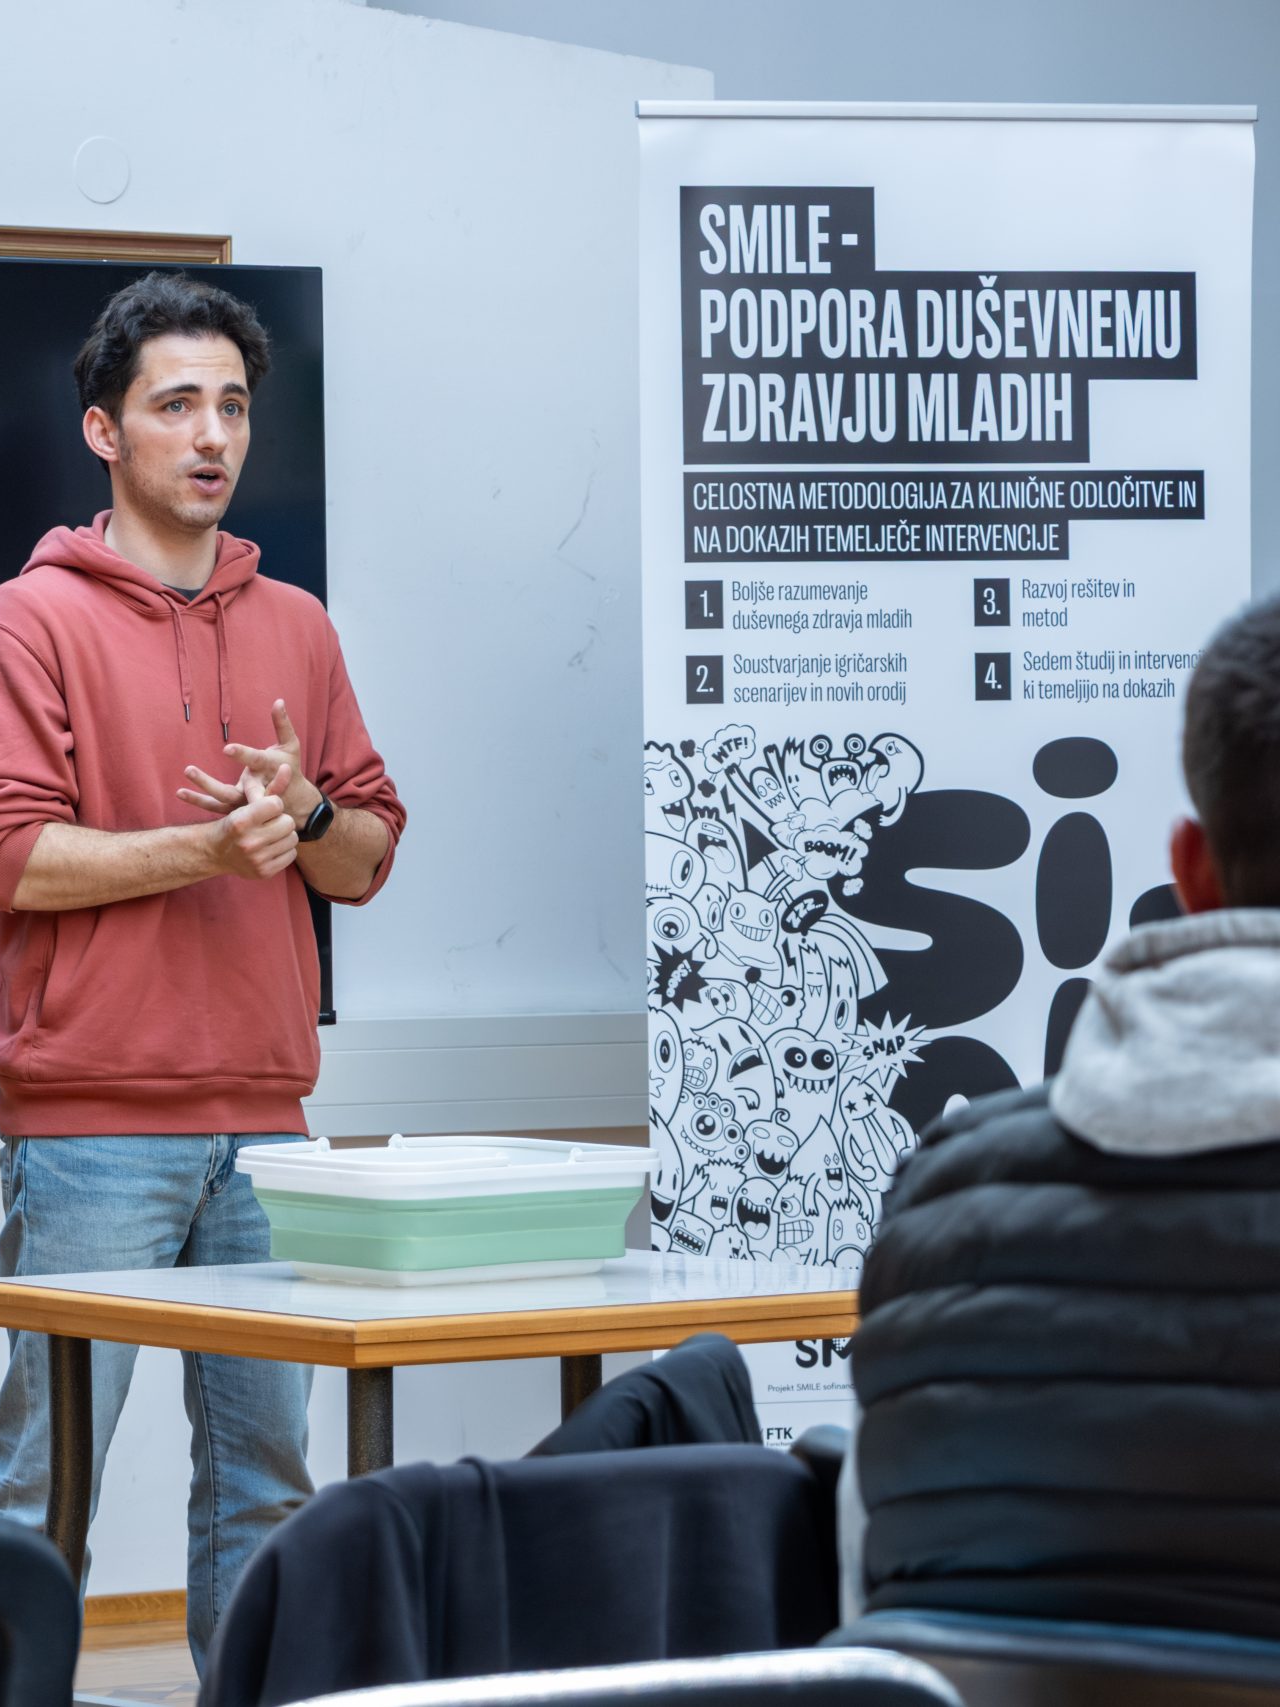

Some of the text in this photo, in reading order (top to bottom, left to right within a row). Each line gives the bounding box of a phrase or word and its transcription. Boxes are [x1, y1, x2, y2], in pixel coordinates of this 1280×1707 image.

[699, 203, 832, 275] SMILE
[700, 275, 1181, 359] PODPORA DUŠEVNEMU
[701, 372, 1073, 443] ZDRAVJU MLADIH
[693, 475, 1196, 511] CELOSTNA METODOLOGIJA ZA KLINIČNE ODLOČITVE IN
[693, 519, 1060, 554] NA DOKAZIH TEMELJEČE INTERVENCIJE
[699, 589, 714, 618] 1.
[732, 580, 868, 606] Boljše razumevanje
[983, 587, 1001, 616] 3.
[1022, 578, 1136, 603] Razvoj rešitev in
[732, 608, 913, 634] duševnega zdravja mladih
[1022, 607, 1068, 628] metod
[733, 652, 908, 678] Soustvarjanje igričarskih
[1023, 649, 1206, 674] Sedem študij in intervenc
[696, 664, 714, 693] 2.
[984, 661, 1002, 690] 4.
[733, 681, 907, 707] scenarijev in novih orodij
[1023, 678, 1175, 703] ki temeljijo na dokazih
[711, 736, 748, 765] WTF!
[804, 840, 857, 866] BOOM!
[862, 1034, 906, 1061] SNAP
[767, 1383, 795, 1394] Projekt
[796, 1382, 821, 1392] SMILE
[766, 1426, 793, 1440] FTK
